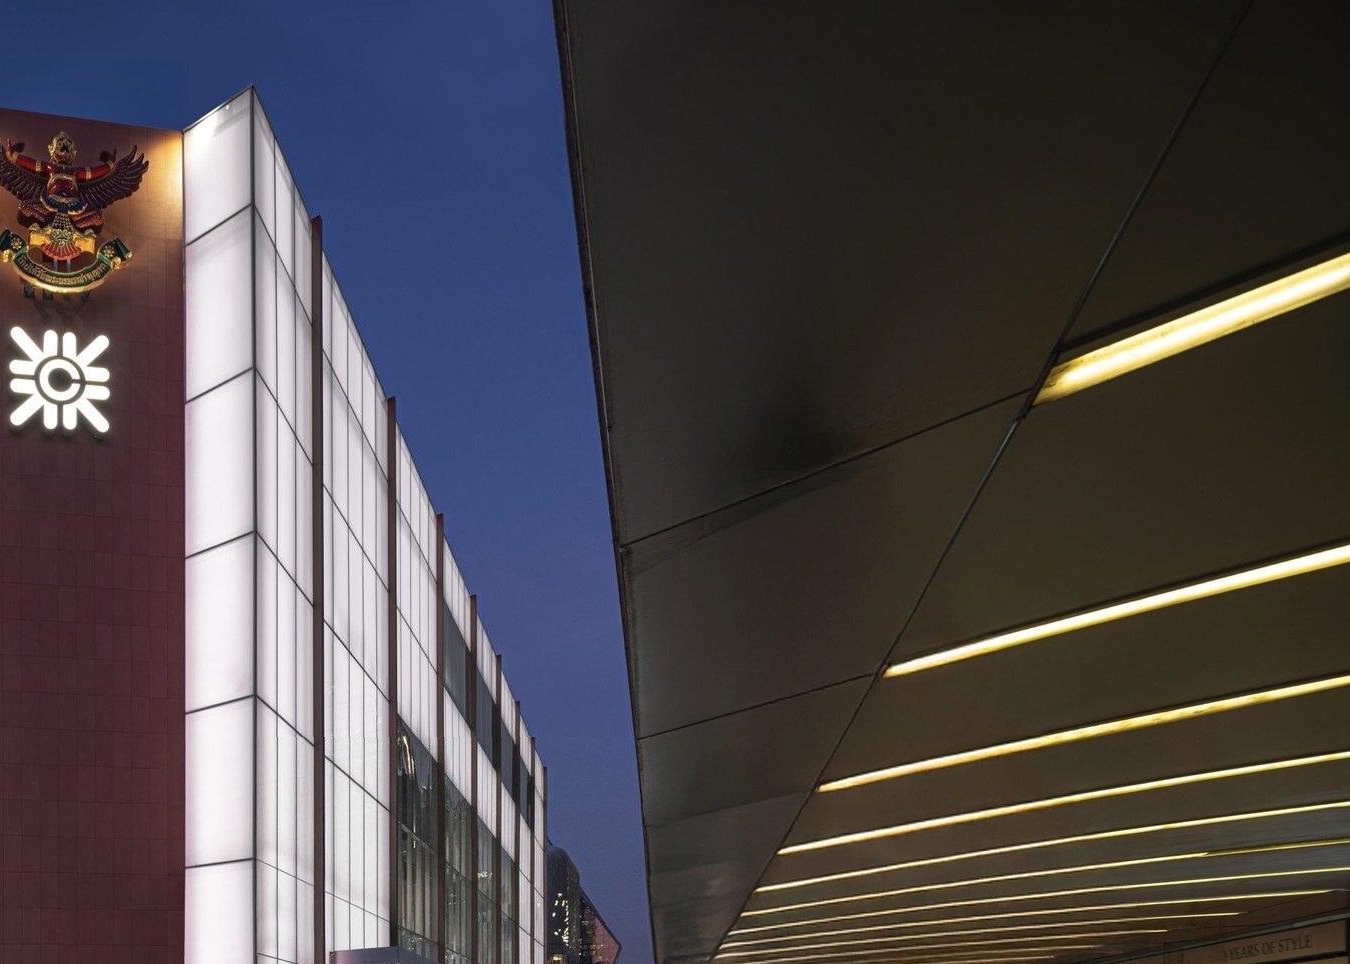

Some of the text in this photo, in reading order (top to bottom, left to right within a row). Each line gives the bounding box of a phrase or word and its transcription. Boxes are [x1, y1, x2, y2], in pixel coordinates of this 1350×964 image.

[1228, 943, 1260, 960] YEARS
[1262, 941, 1277, 955] OF
[1278, 934, 1313, 953] STYLE
